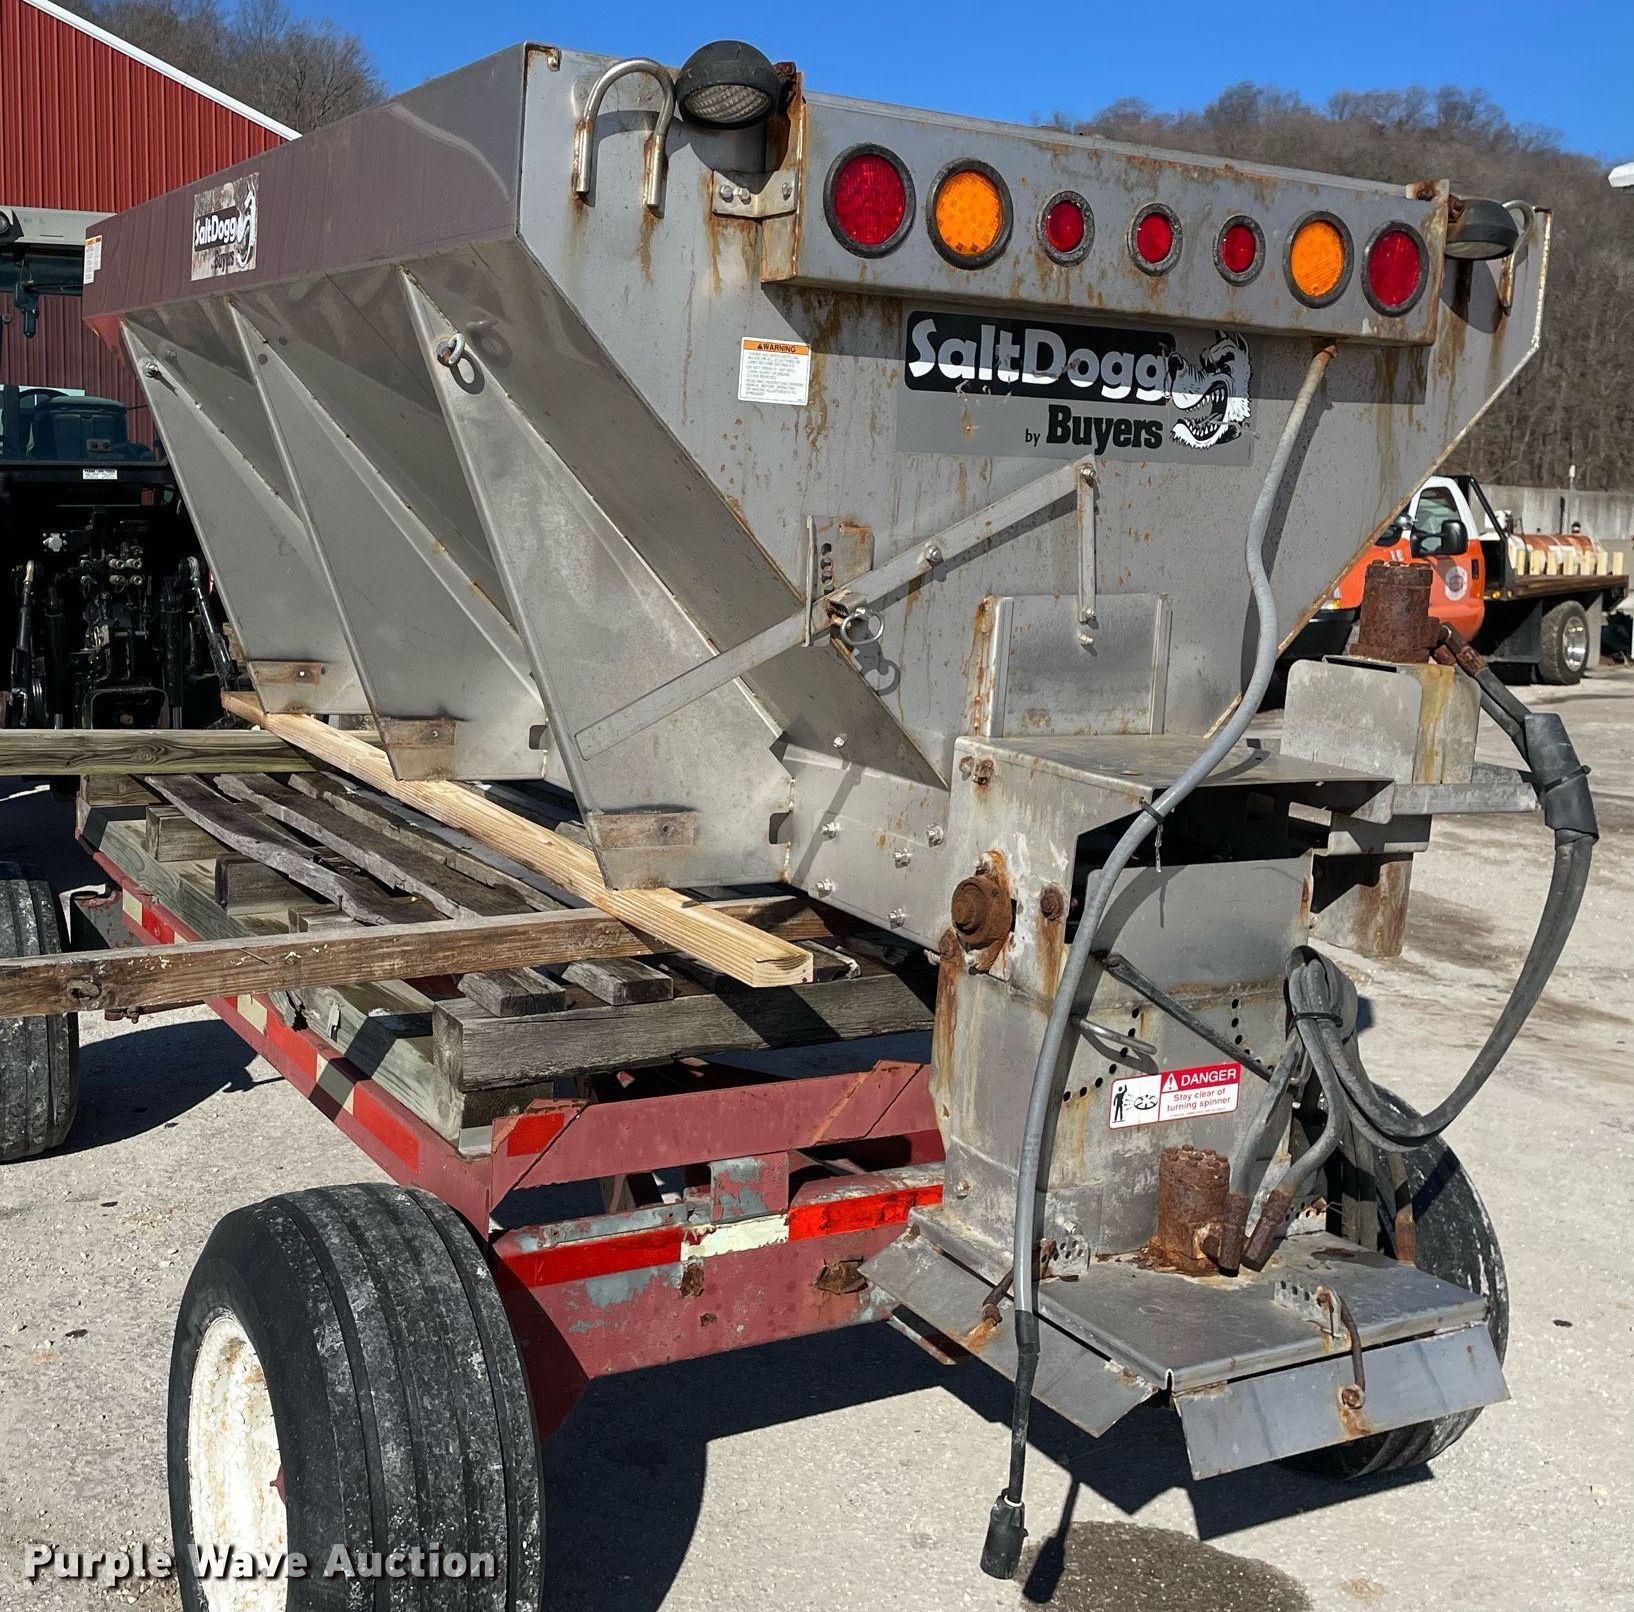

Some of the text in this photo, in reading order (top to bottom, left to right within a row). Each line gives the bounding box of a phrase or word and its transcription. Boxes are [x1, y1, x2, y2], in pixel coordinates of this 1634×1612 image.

[195, 214, 238, 247] SaltDogg
[763, 343, 796, 353] WARNING
[908, 318, 1170, 402] SaltDogg
[1025, 404, 1163, 456] by Buyers
[1181, 1068, 1237, 1086] DANGER
[1173, 1088, 1226, 1102] Stay clear of
[1167, 1101, 1197, 1112] turning
